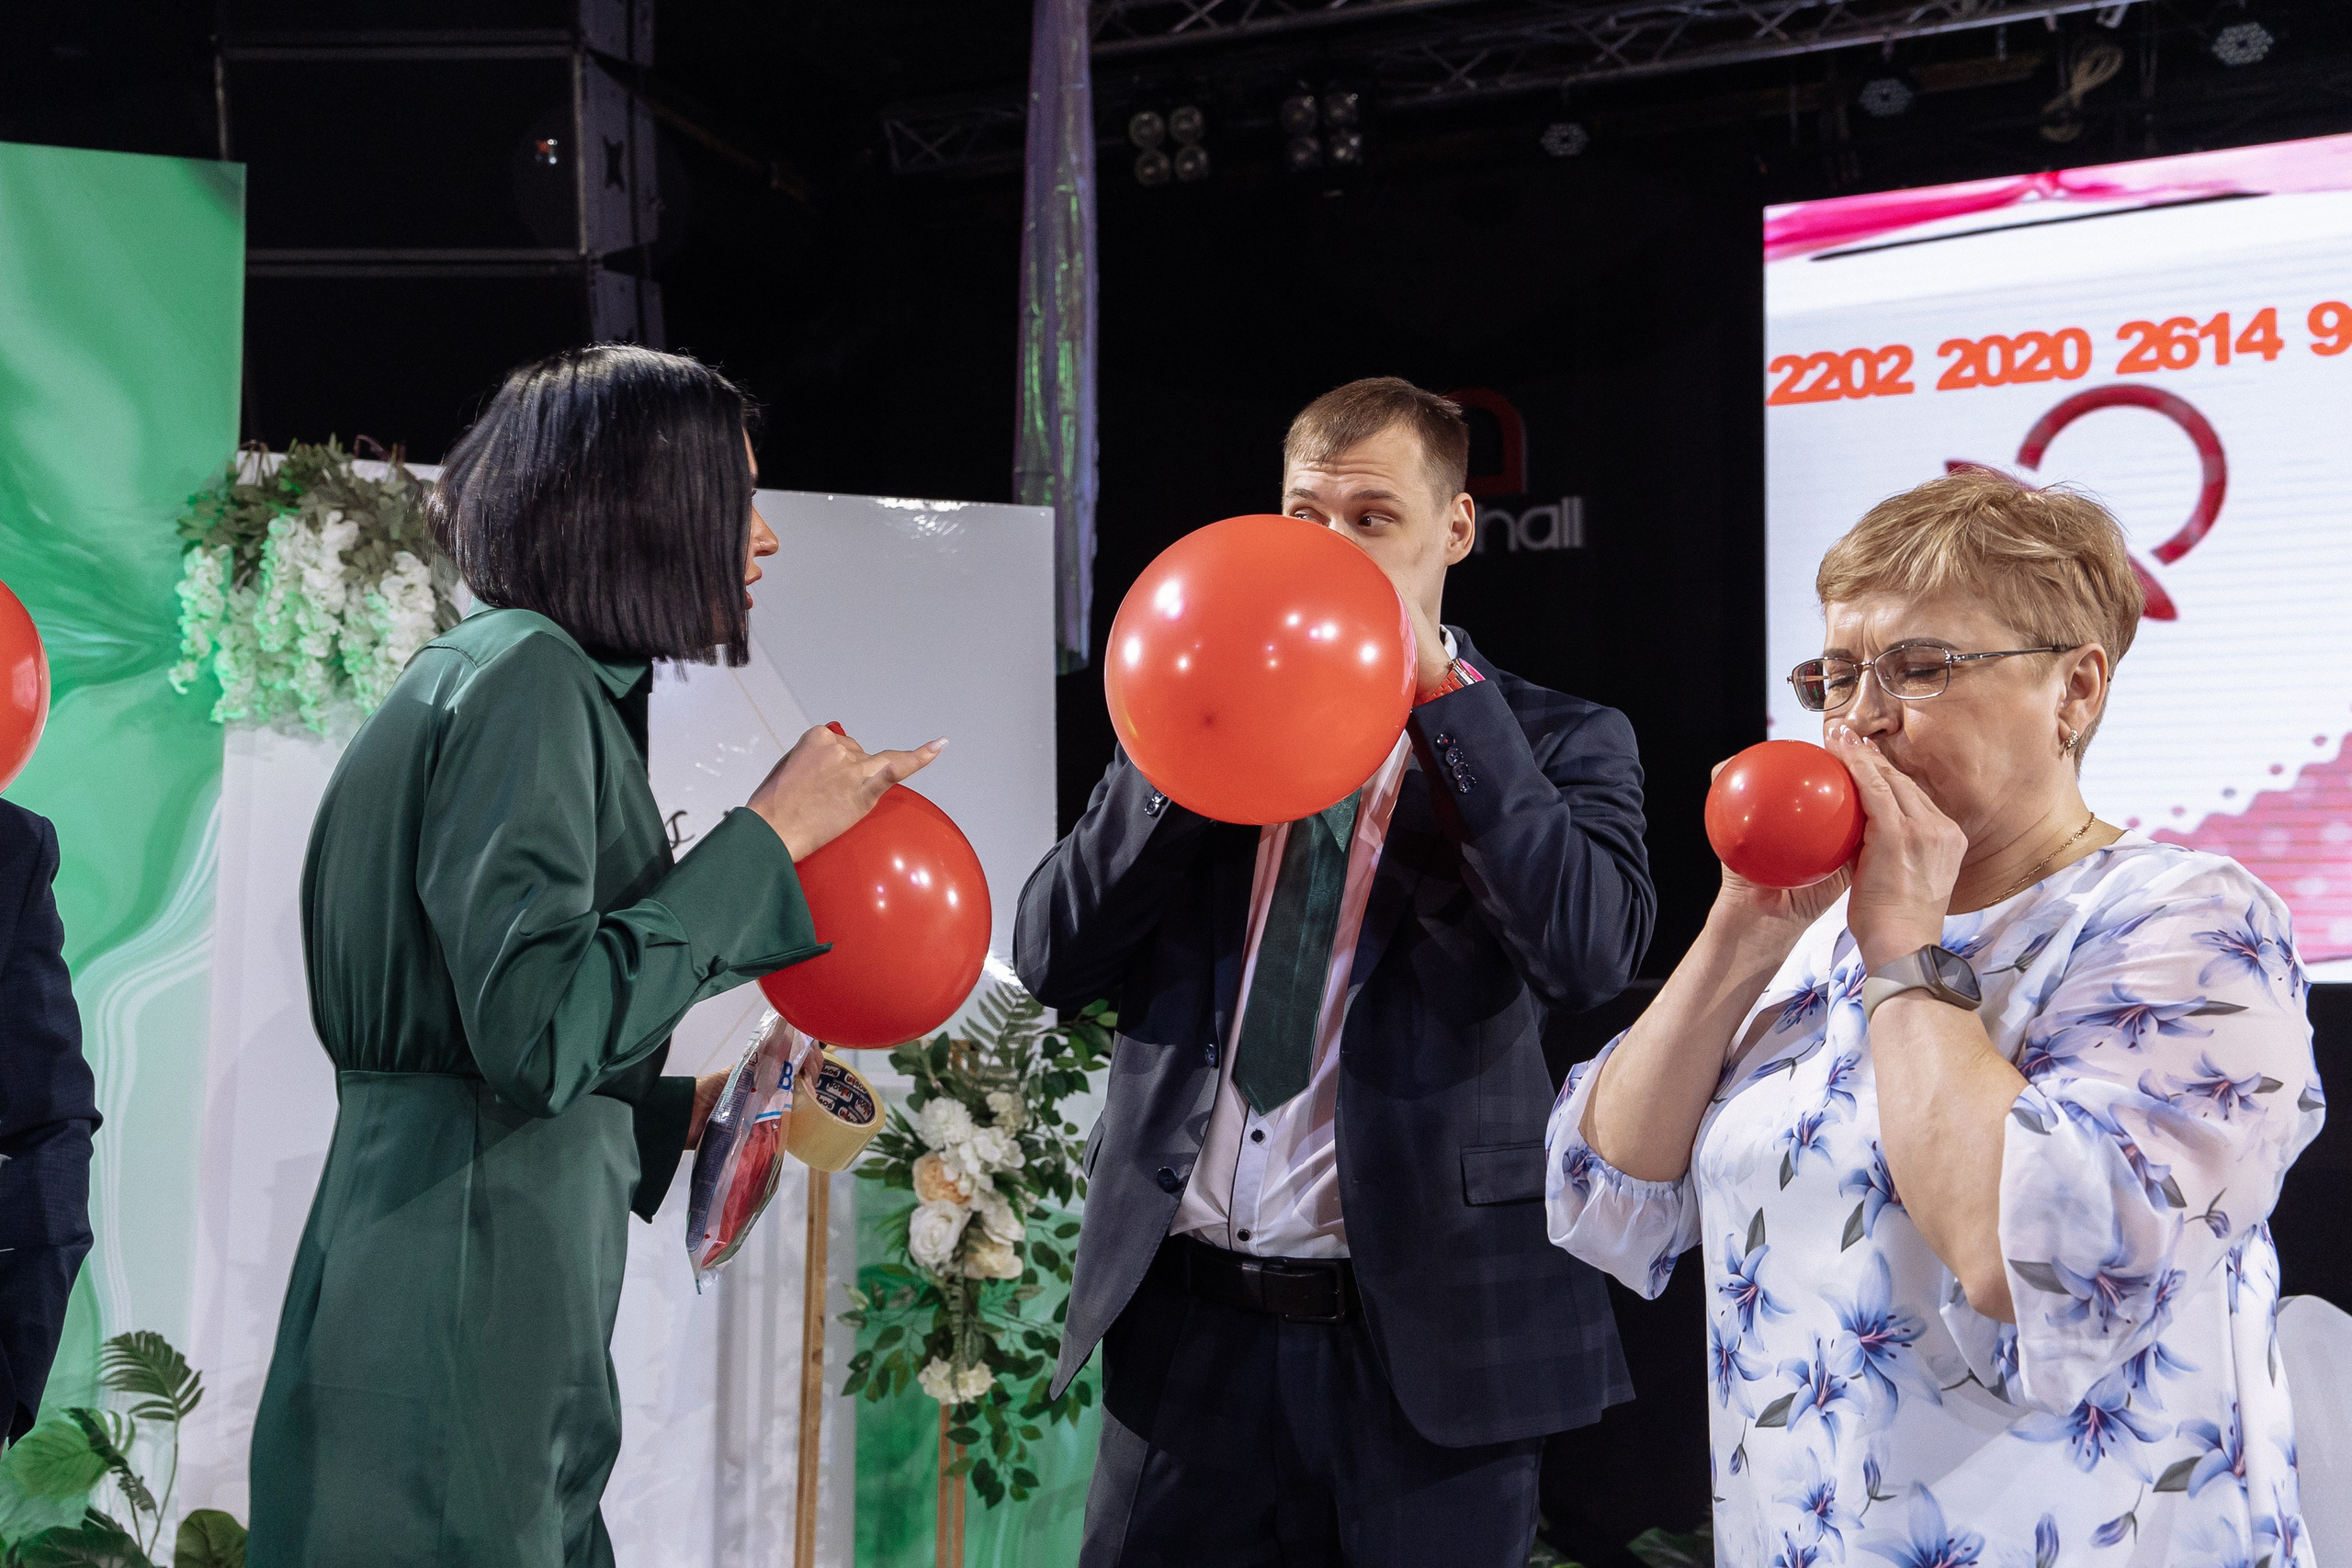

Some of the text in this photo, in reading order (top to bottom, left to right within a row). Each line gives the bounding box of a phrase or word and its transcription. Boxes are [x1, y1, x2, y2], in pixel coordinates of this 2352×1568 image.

[1767, 344, 1916, 405] 2202
[1936, 327, 2093, 390] 2020
[2115, 307, 2285, 375] 2614
